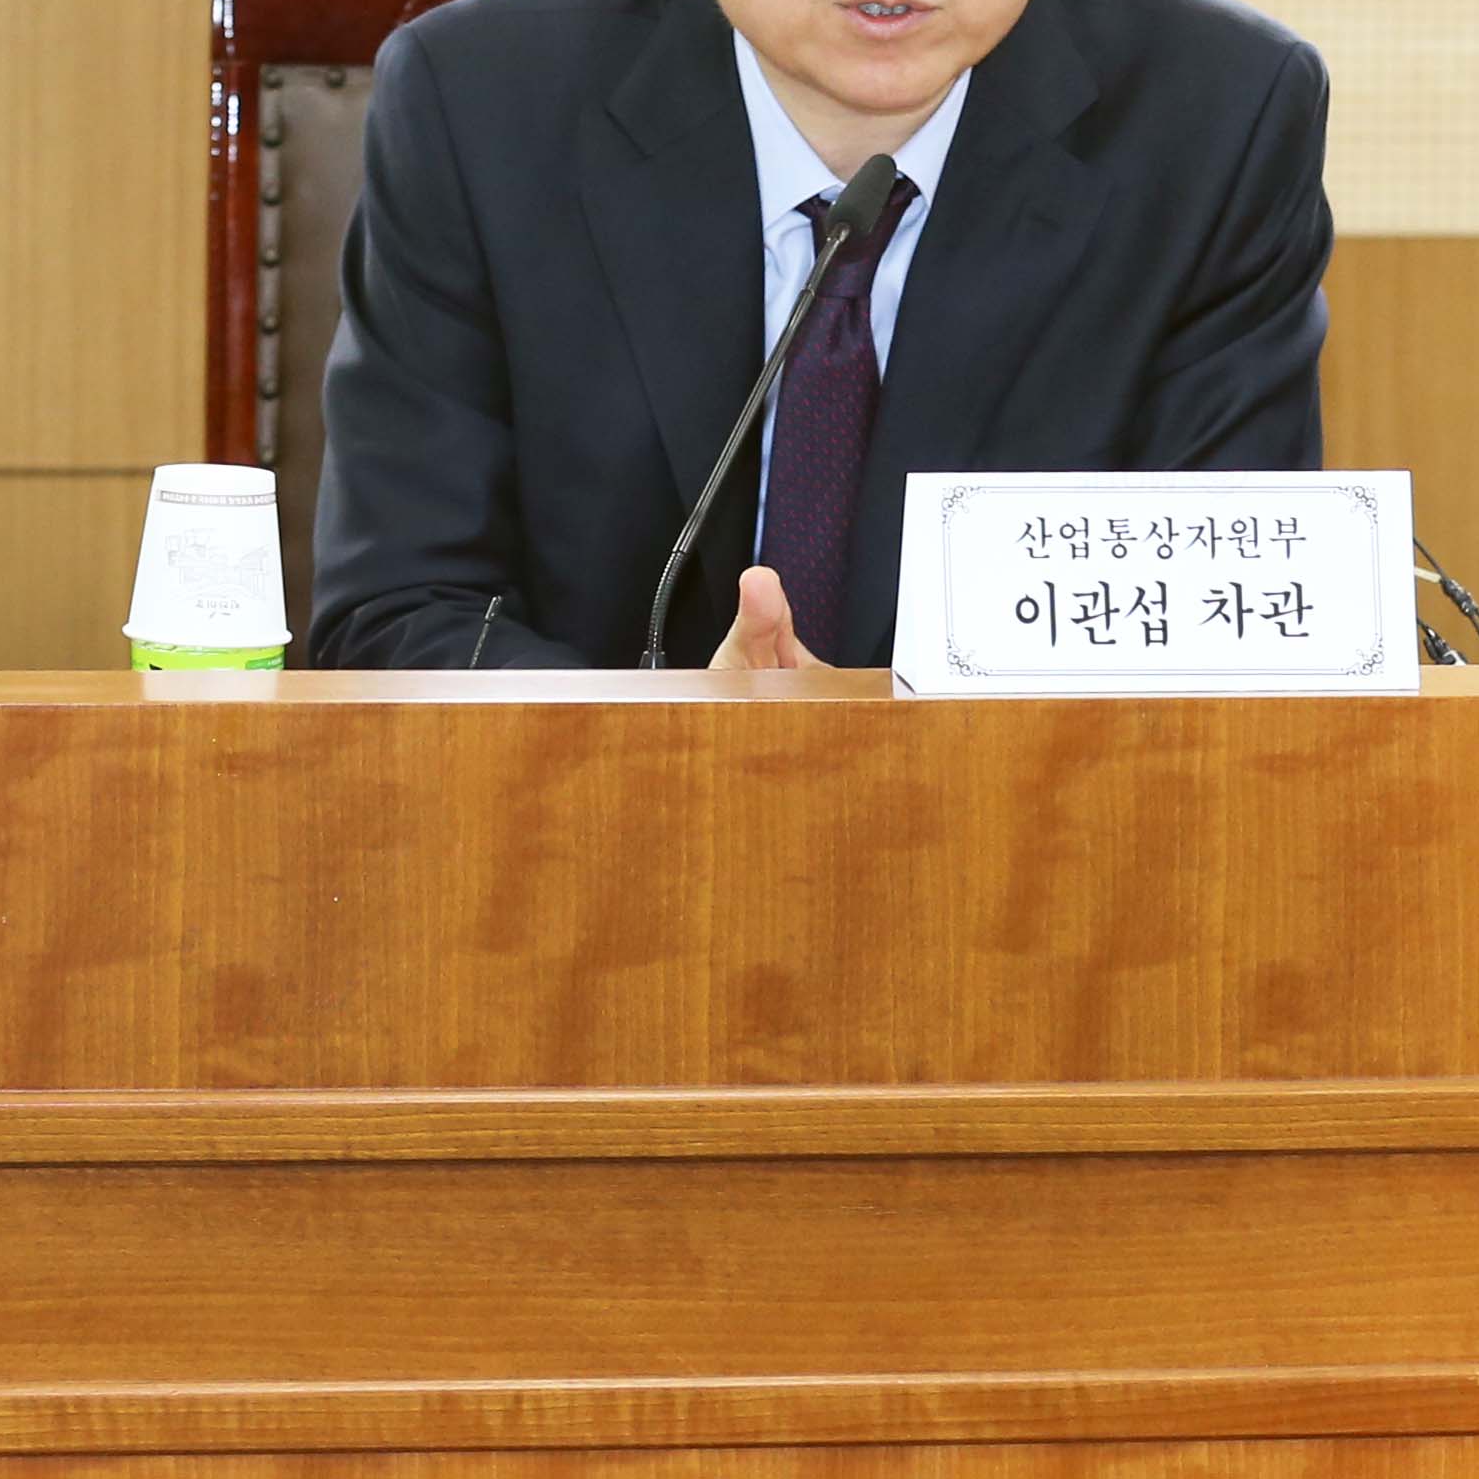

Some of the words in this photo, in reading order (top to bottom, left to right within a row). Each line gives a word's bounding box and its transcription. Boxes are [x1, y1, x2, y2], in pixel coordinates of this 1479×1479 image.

[1015, 516, 1306, 560] 산업통상자원부
[1015, 580, 1169, 648] 이관섭
[1198, 581, 1314, 640] 차관
